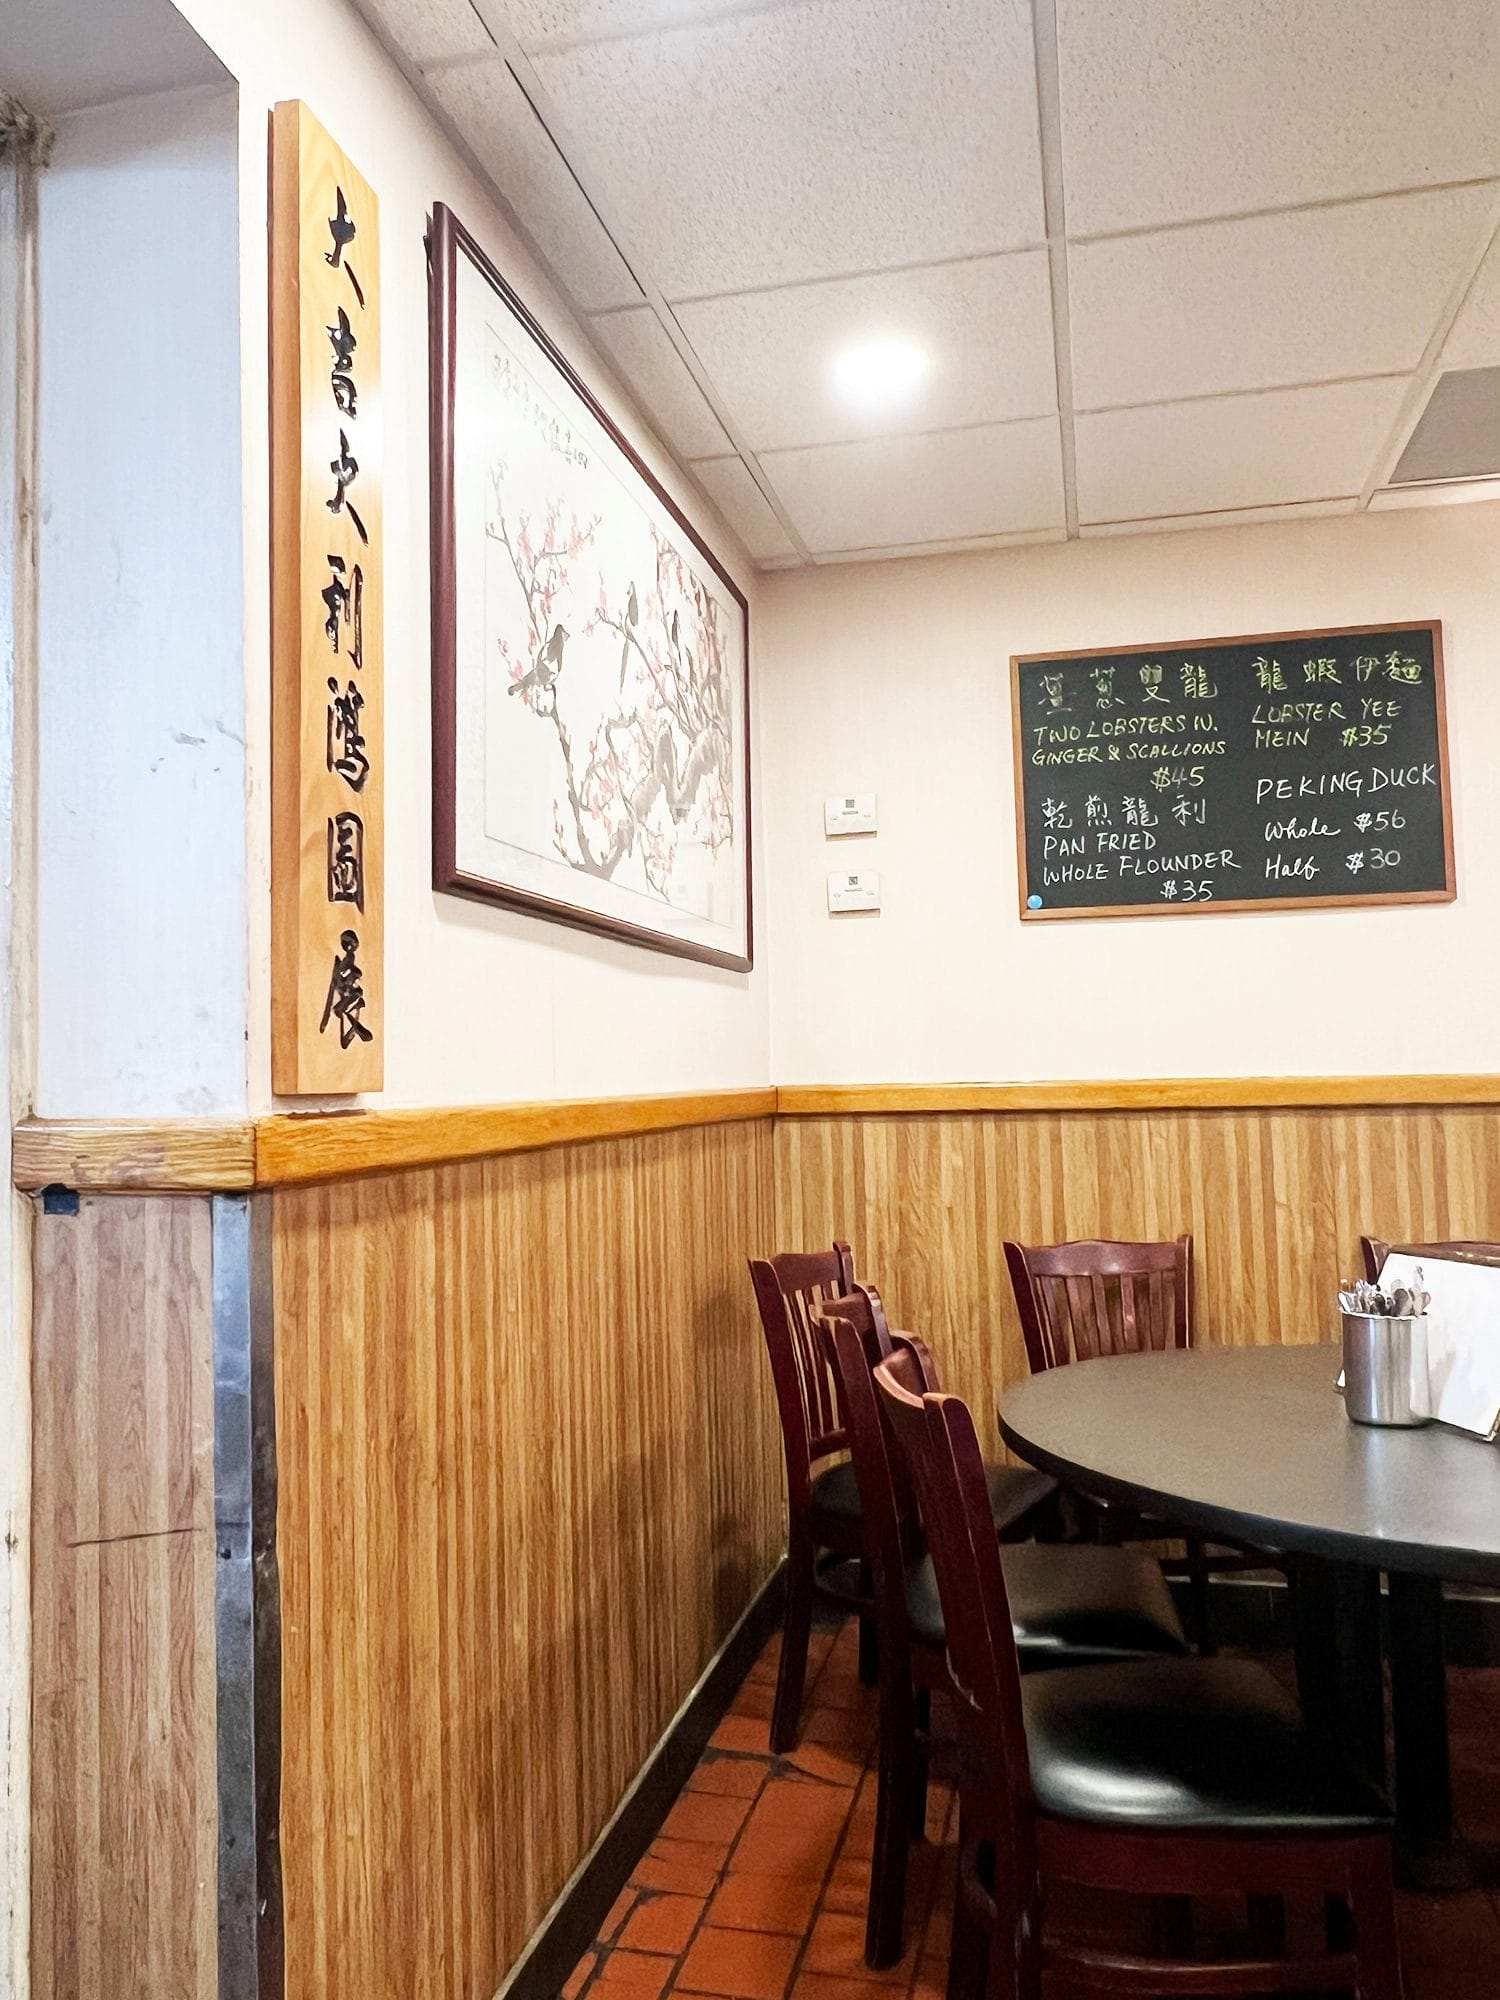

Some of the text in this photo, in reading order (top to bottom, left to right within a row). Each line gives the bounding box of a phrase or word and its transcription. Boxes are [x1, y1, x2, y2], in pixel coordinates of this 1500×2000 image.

[1252, 698, 1402, 724] LOBSTER YEE
[1033, 725, 1081, 746] TWO
[1086, 714, 1187, 738] LOBSTERS
[1255, 723, 1393, 749] MEIN $35
[1032, 741, 1226, 767] GINGER & SCALLIONS
[1150, 766, 1206, 793] $45
[1257, 763, 1437, 805] PEKING DUCK
[1264, 809, 1406, 841] Whole $56
[1043, 830, 1157, 860] PAN FRIED
[1043, 849, 1242, 887] WHOLE FLOUNDER
[1265, 853, 1321, 881] Half
